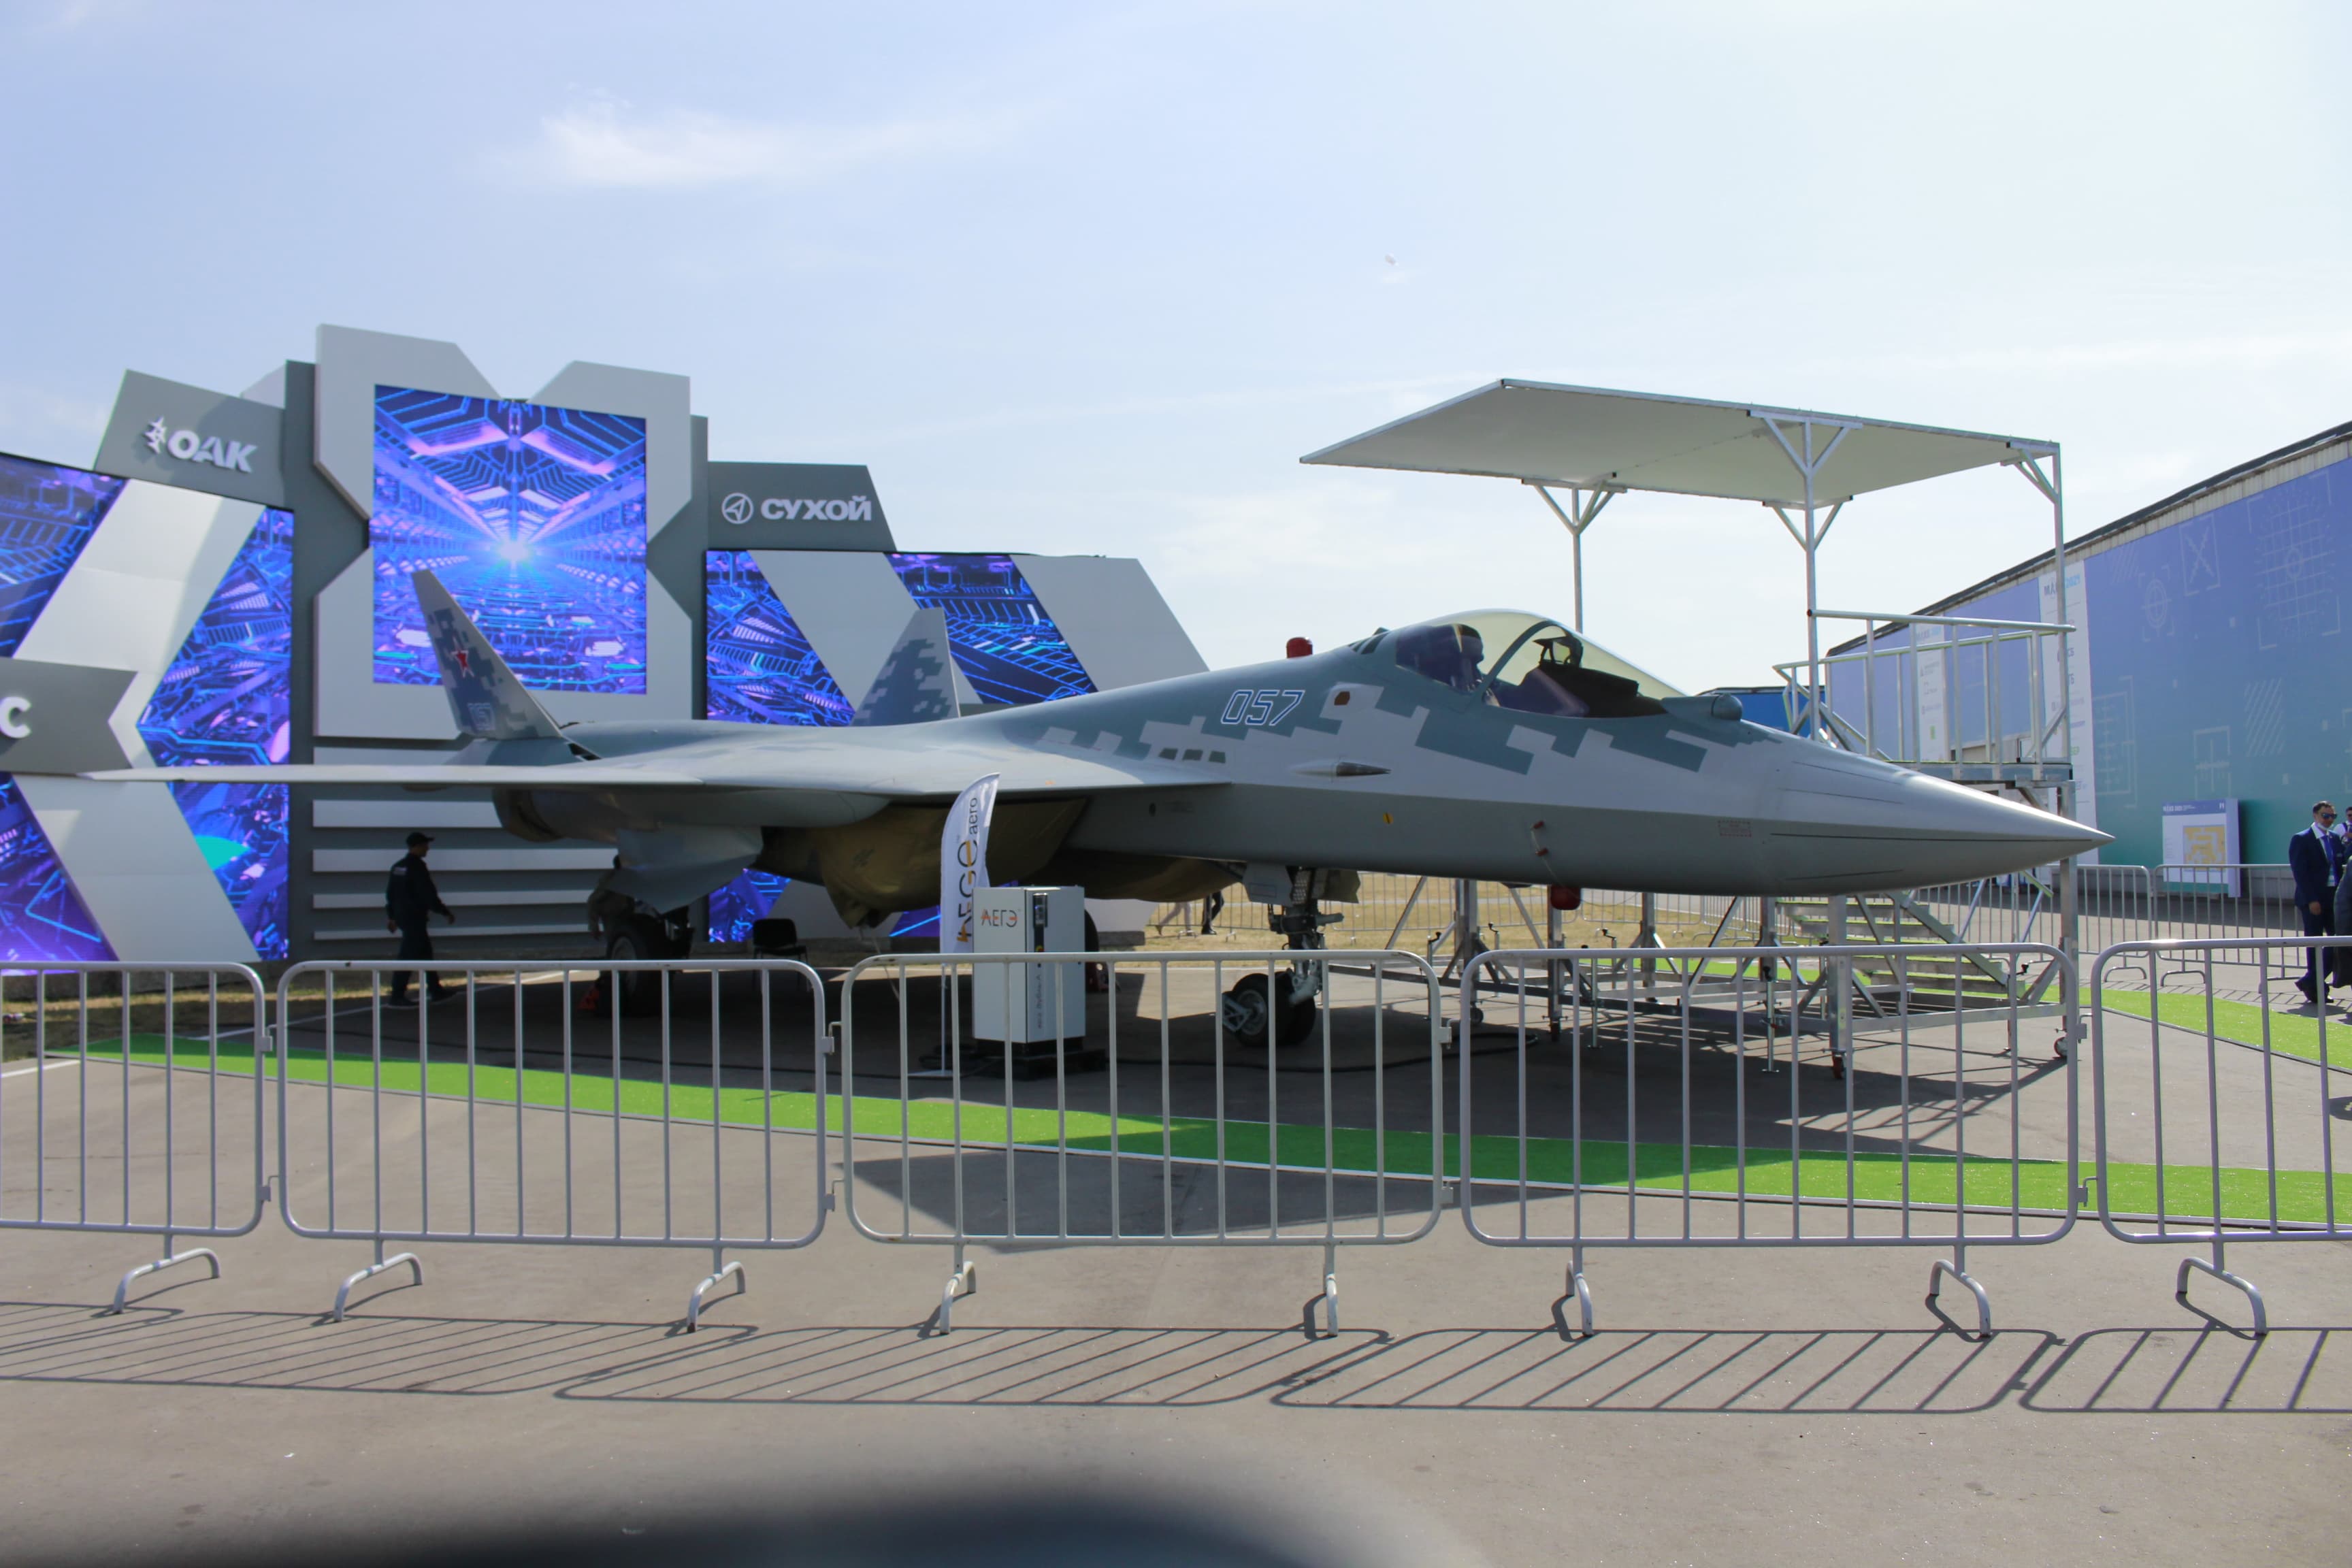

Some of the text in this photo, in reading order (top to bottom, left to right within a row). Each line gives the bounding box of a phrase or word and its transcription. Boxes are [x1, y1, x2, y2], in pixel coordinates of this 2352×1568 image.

[167, 430, 257, 473] ОАК
[761, 495, 872, 521] СУХОЙ
[1221, 689, 1305, 726] 057
[969, 797, 978, 835] aero
[981, 909, 1018, 928] АЕГЭ
